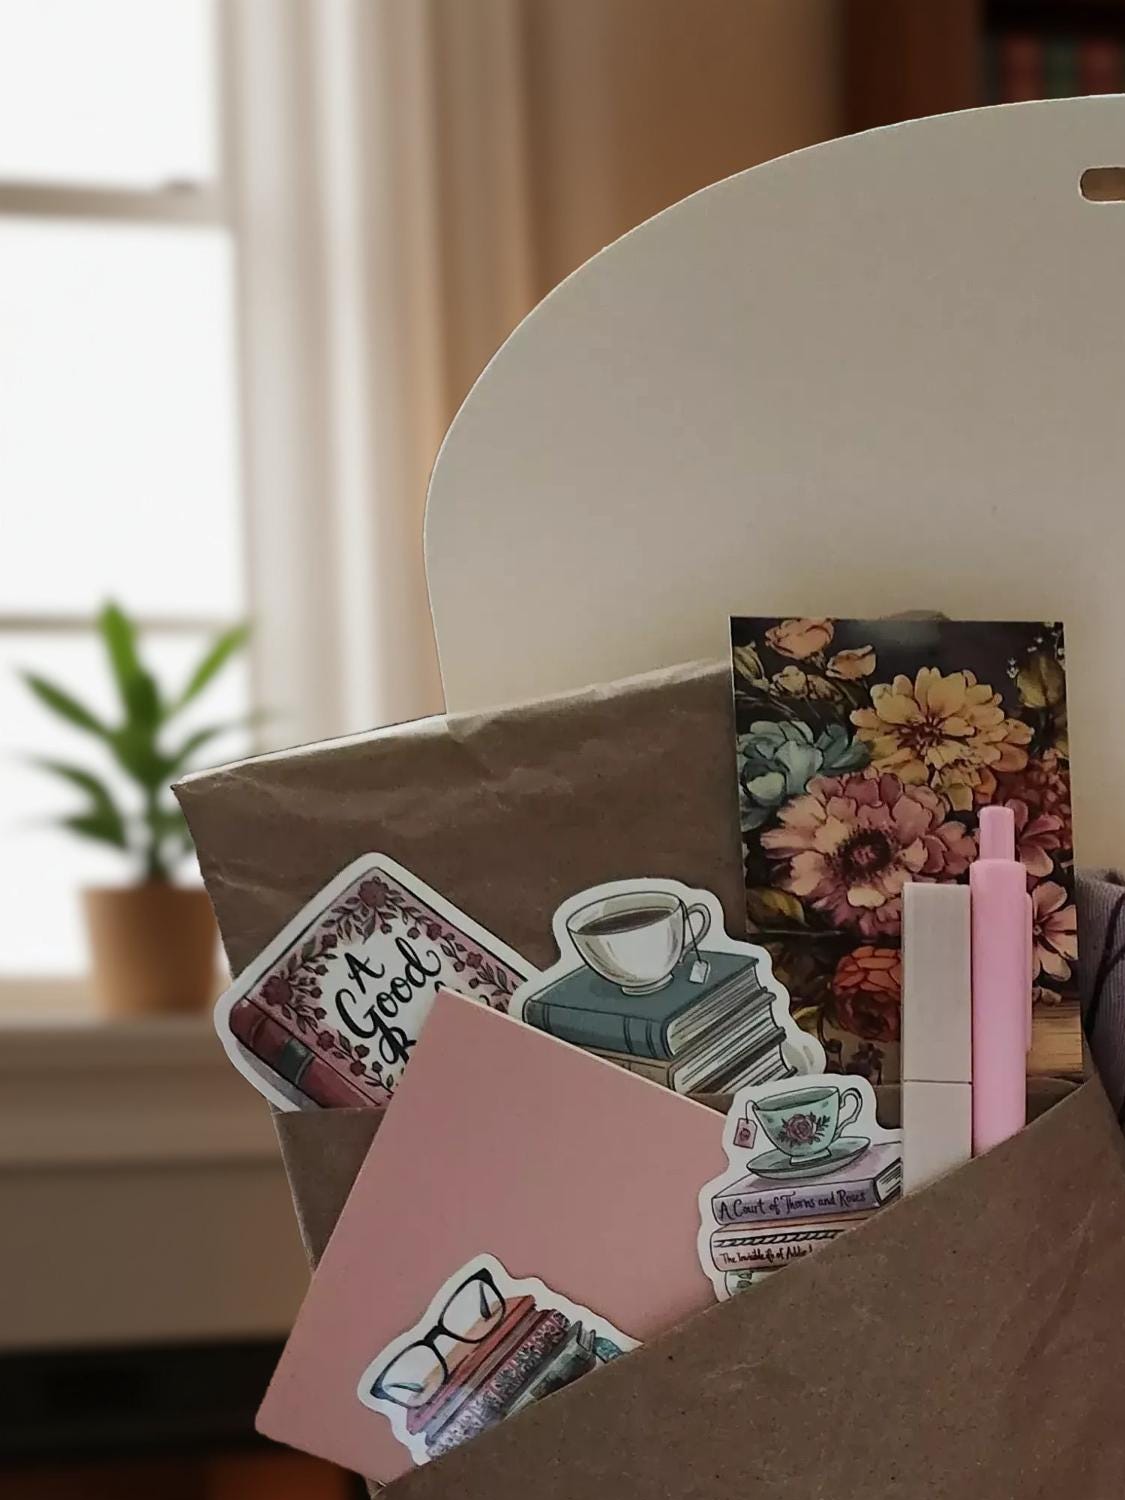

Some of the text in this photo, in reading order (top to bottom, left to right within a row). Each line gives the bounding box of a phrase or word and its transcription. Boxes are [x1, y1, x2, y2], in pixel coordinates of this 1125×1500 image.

[335, 936, 441, 1040] Good
[343, 951, 385, 995] A
[719, 1189, 867, 1220] A Court of Thorns and Roses
[720, 1253, 737, 1265] The
